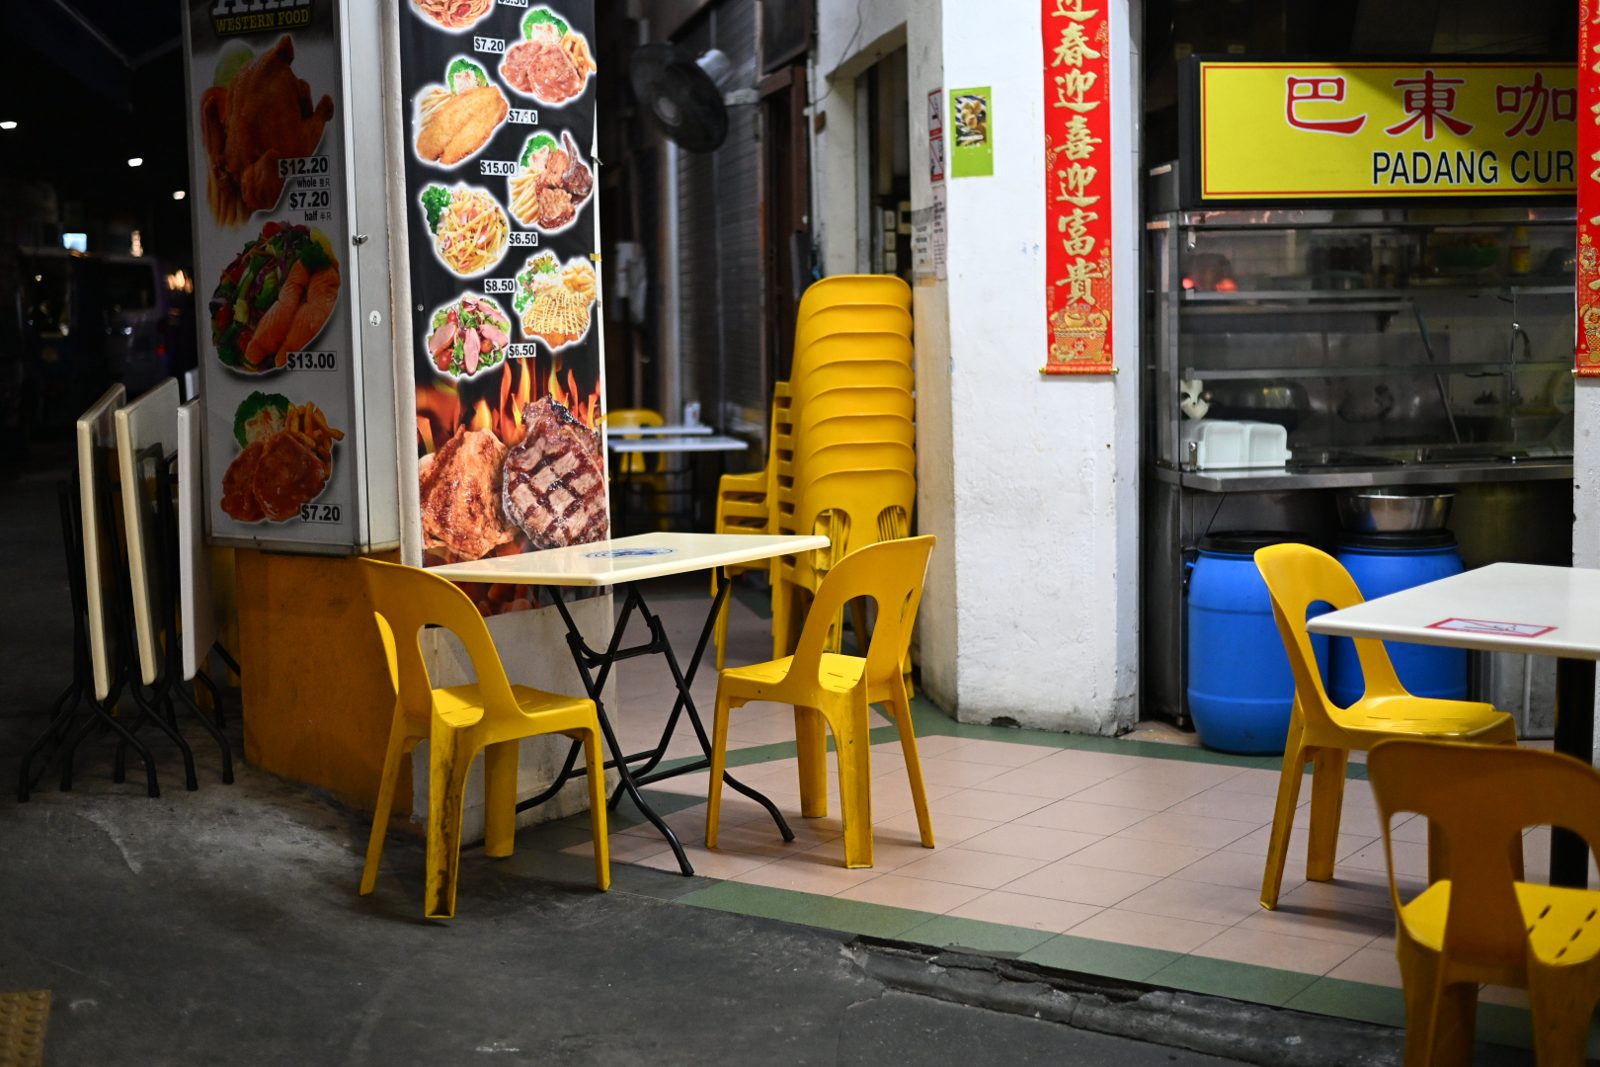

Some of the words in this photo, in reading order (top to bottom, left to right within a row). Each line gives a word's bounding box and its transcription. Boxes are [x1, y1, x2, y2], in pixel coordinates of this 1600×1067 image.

[215, 13, 276, 33] WESTERN
[277, 8, 309, 25] FOOD
[475, 38, 504, 52] $7.20
[1285, 69, 1577, 141] 巴東咖
[280, 157, 328, 175] $12.20
[480, 161, 515, 174] $15.00
[1372, 150, 1498, 185] PADANG
[1510, 149, 1574, 184] CUR
[297, 177, 317, 188] whole
[290, 191, 329, 210] $7.20
[304, 210, 318, 222] half
[509, 233, 537, 245] $6.50
[486, 279, 514, 291] $8.50
[509, 344, 535, 357] $6.50
[287, 353, 336, 370] $13.00
[301, 504, 341, 523] $7.20
